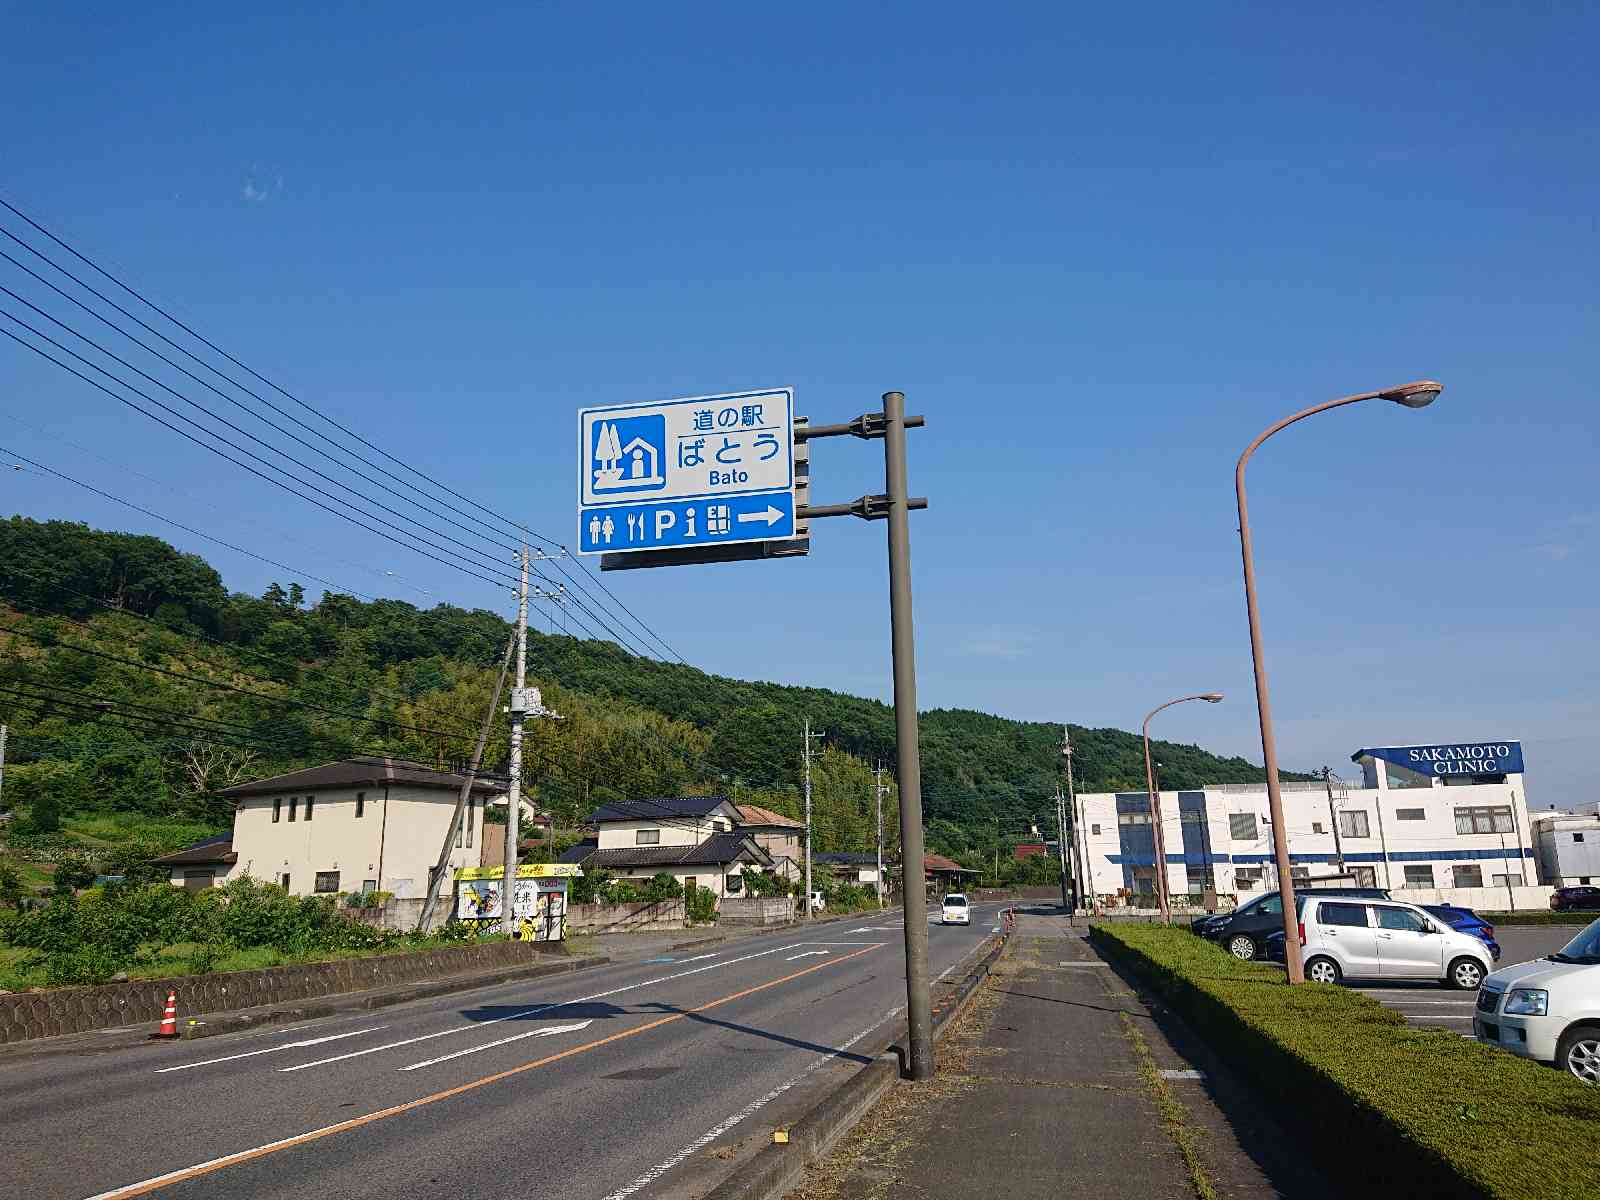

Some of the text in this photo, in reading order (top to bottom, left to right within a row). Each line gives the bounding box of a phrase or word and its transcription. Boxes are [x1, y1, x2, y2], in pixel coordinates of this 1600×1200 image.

[693, 404, 764, 431] 道の駅
[678, 433, 779, 469] ばとう
[709, 468, 749, 486] Bato
[1409, 745, 1510, 761] SAKAMOTO
[1433, 759, 1497, 774] CLINIC
